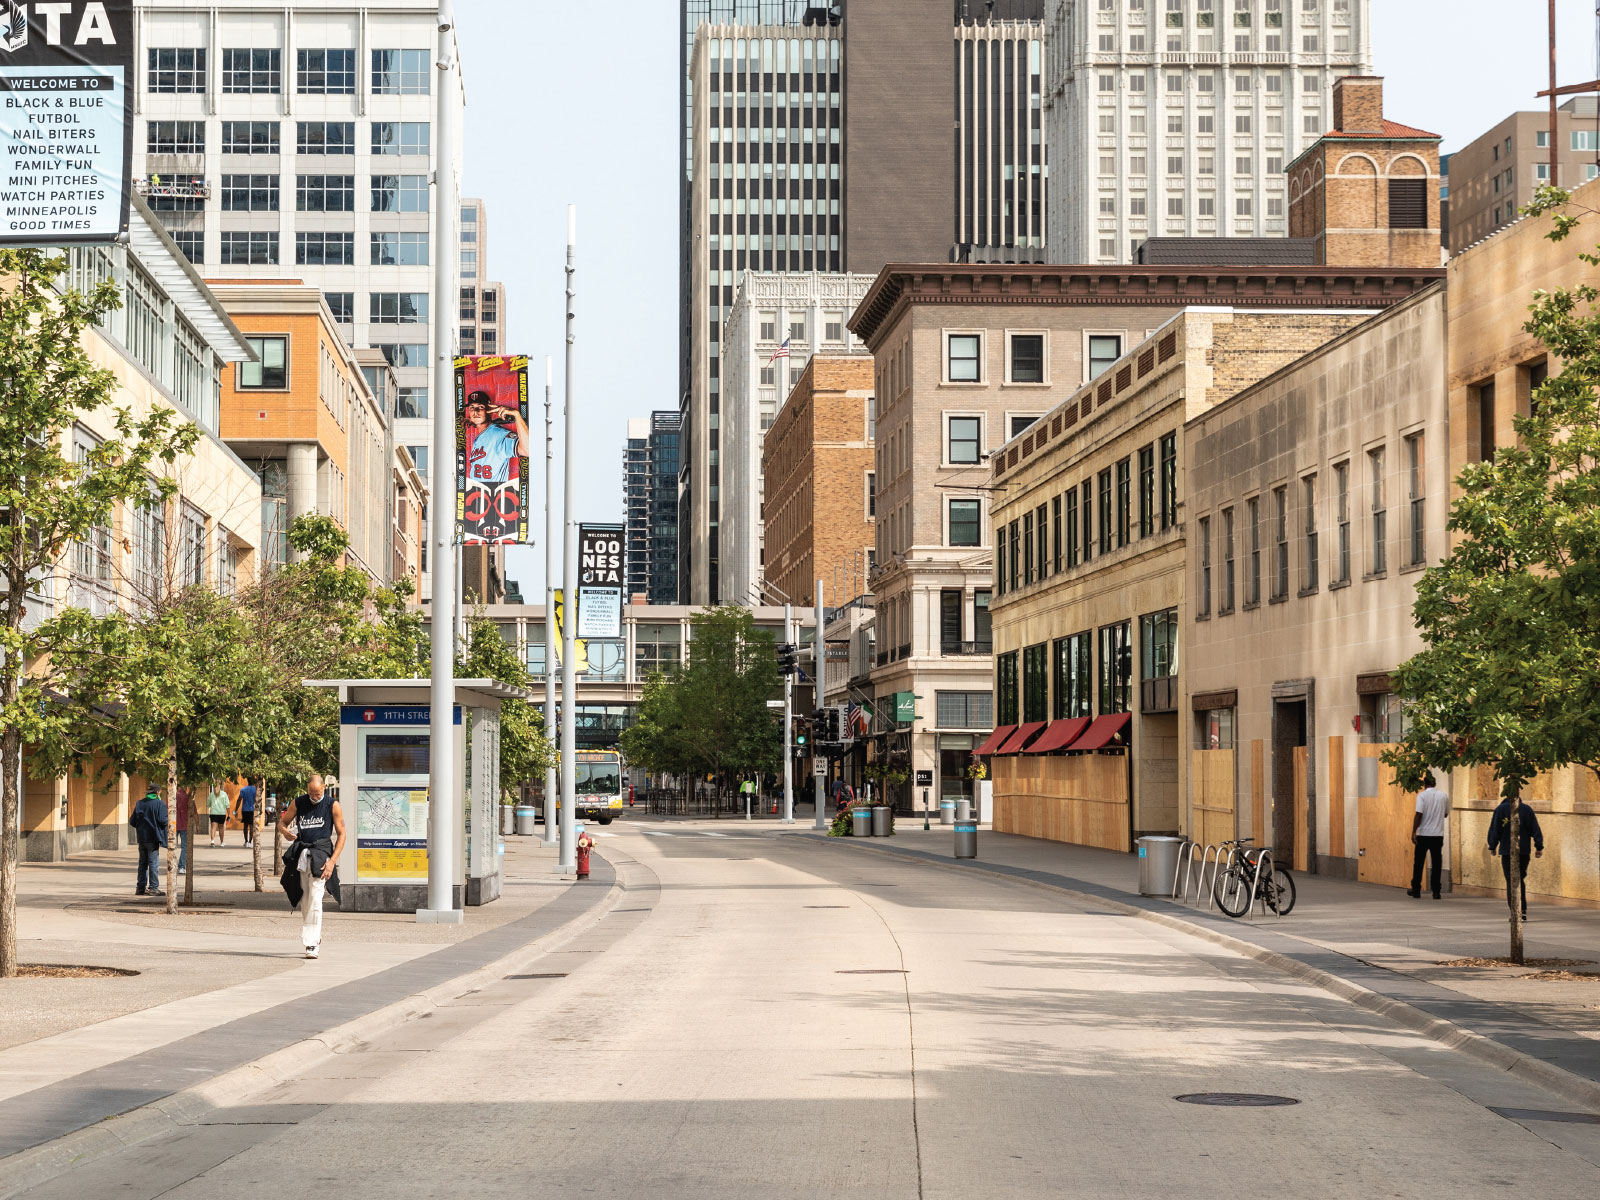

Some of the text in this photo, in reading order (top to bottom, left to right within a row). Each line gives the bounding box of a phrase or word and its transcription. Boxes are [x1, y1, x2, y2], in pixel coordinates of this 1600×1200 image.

[11, 79, 99, 89] WELCOME TO
[6, 98, 104, 108] BLACK & BLUE
[29, 114, 80, 124] FUTBOL
[13, 129, 96, 139] NAIL BITERS
[8, 145, 101, 154] WONDERWALL
[15, 160, 92, 170] FAMILY FUN
[9, 176, 98, 186] MINI PITCHES
[0, 190, 105, 201] WATCH PARTIES
[6, 206, 97, 216] MINNEAPOLIS
[10, 220, 91, 230] GOOD TIMES
[478, 356, 504, 372] Twins
[474, 464, 492, 479] 26
[583, 540, 620, 554] LOO
[583, 555, 620, 568] NES
[384, 712, 404, 720] 11TH
